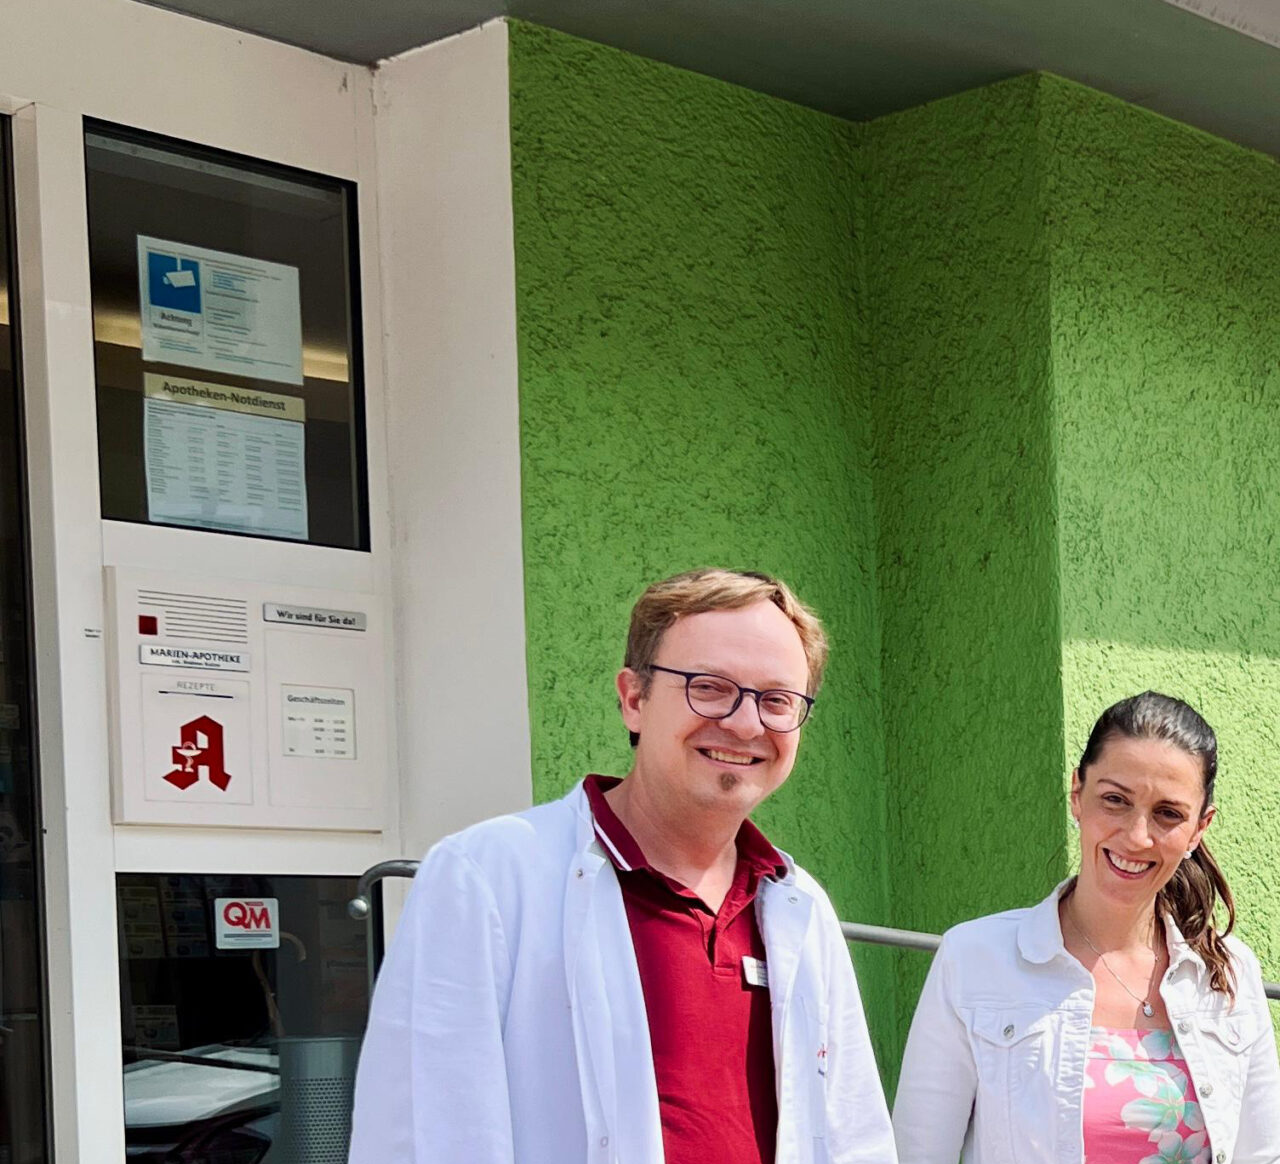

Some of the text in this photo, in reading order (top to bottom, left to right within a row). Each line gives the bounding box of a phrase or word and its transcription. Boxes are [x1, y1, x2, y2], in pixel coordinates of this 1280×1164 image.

[163, 381, 286, 411] Apotheken-Notdienst
[276, 610, 293, 619] Wir
[295, 613, 312, 621] sind
[314, 613, 327, 622] für
[328, 615, 340, 624] Sie
[150, 648, 241, 664] MARIEN-APOTHEKE
[176, 681, 215, 691] REZEPTE
[223, 901, 272, 930] QM
